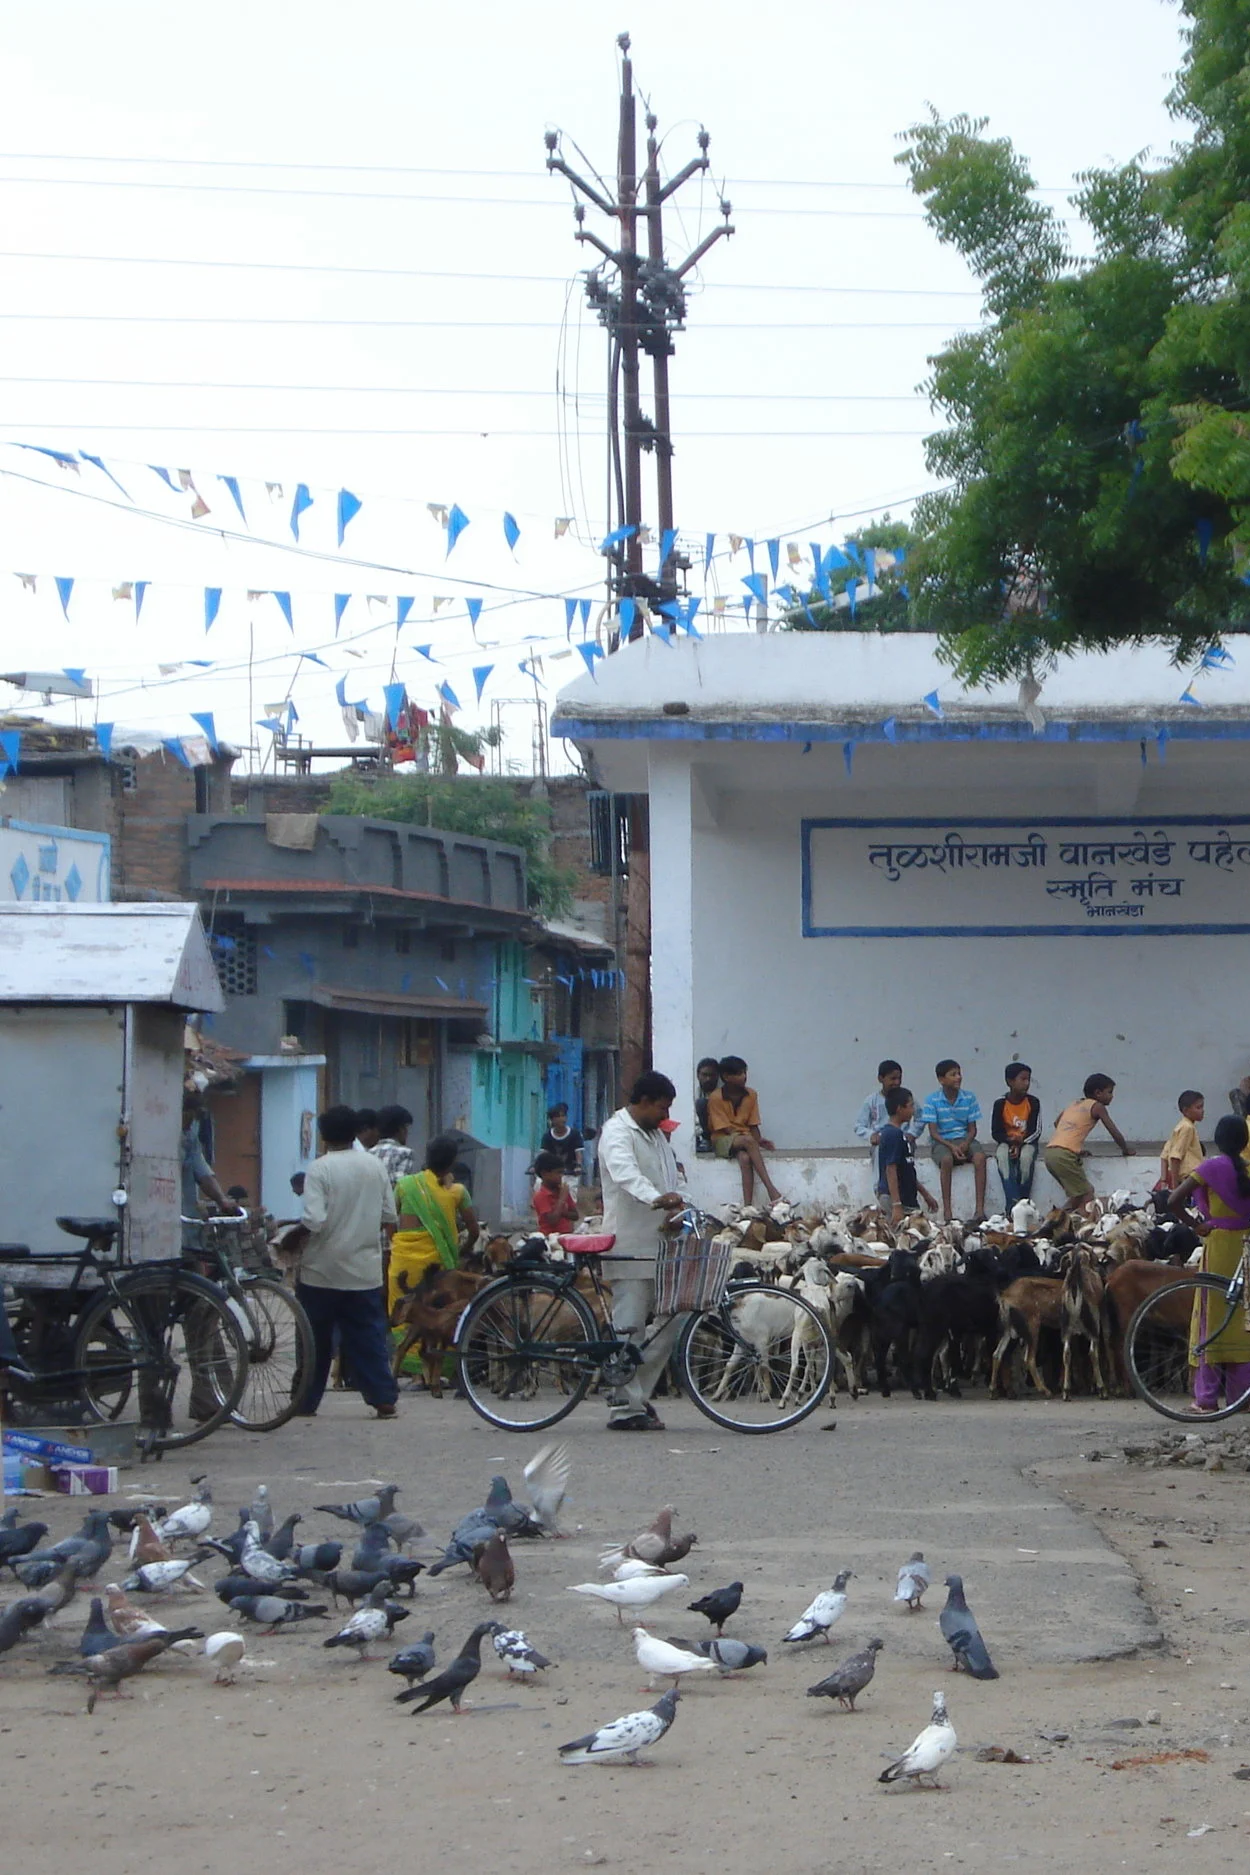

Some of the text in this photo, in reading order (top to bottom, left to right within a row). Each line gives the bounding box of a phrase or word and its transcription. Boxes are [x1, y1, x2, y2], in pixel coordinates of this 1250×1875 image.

[868, 832, 1047, 881] तुळशीरामजी
[1059, 830, 1176, 867] वानखेडे
[1130, 873, 1185, 897] मंच
